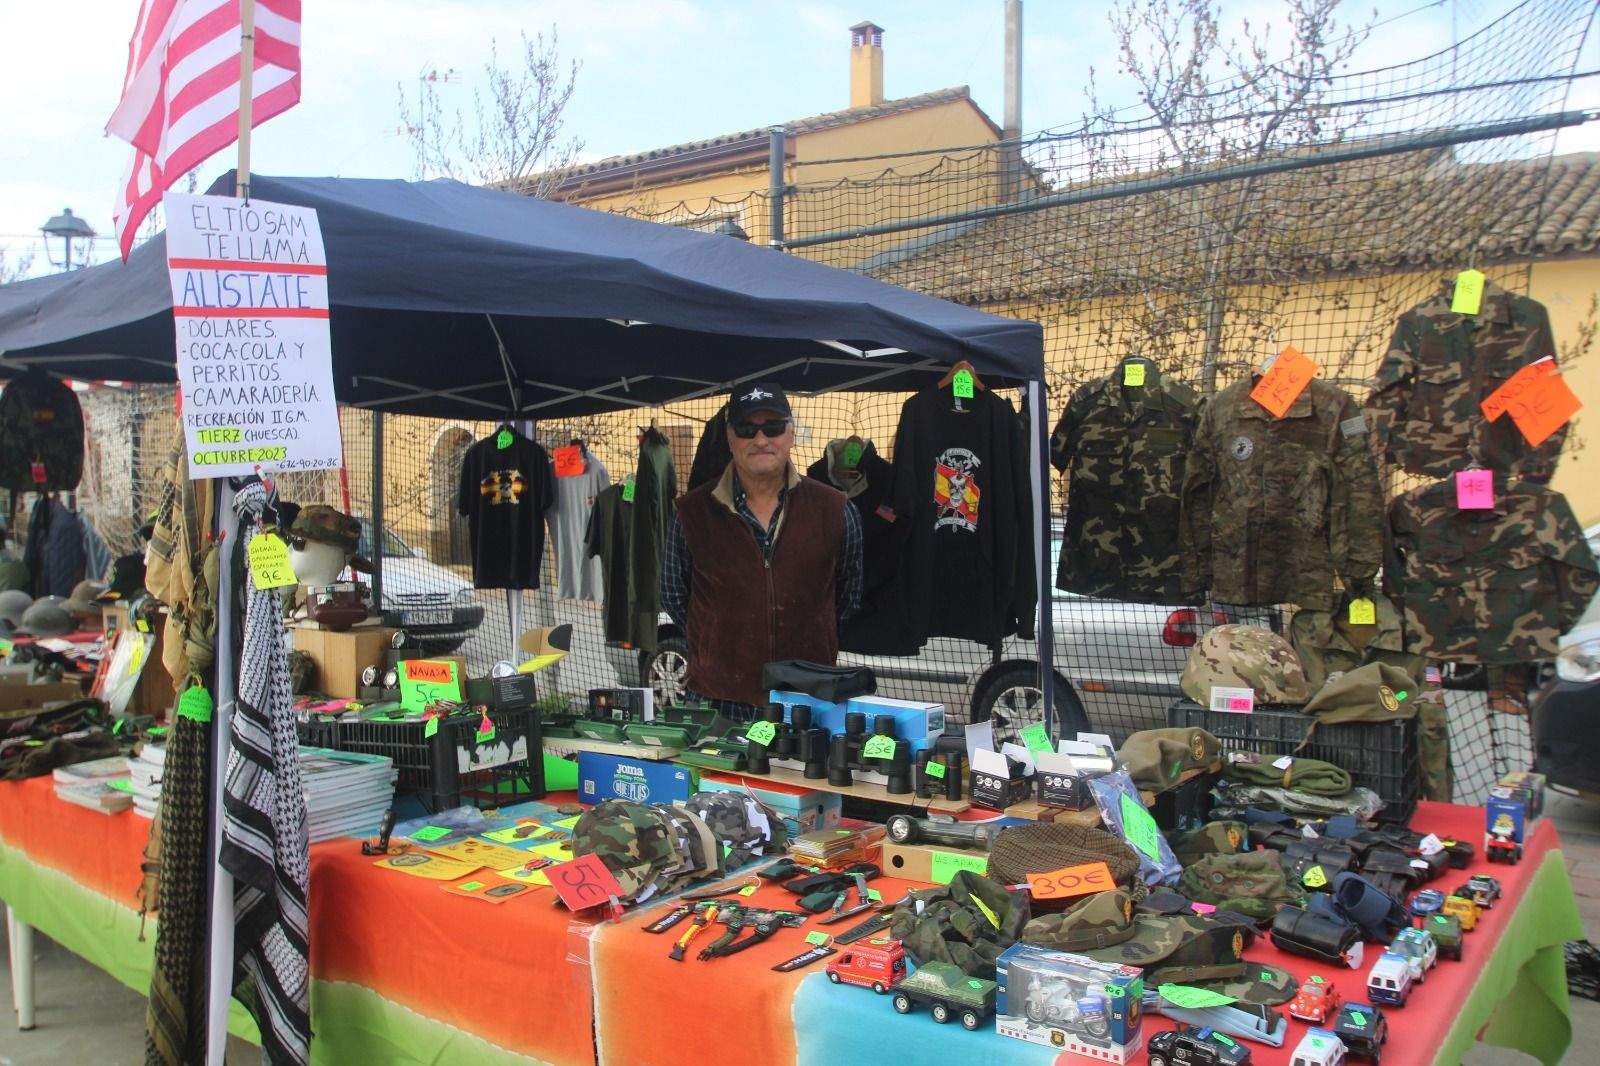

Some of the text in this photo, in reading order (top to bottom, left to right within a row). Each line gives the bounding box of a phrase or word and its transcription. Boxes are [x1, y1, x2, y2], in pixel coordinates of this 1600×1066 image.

[192, 205, 220, 231] EL
[264, 210, 307, 237] SAM
[201, 233, 310, 263] TE LLAMA
[294, 342, 305, 359] Y
[188, 408, 265, 427] RECREACIÓN
[197, 428, 241, 445] TIERZ
[261, 570, 282, 584] 9€
[749, 725, 773, 742] 25€
[865, 741, 892, 755] 25€
[561, 863, 608, 902] 5€
[1032, 869, 1105, 896] 30€
